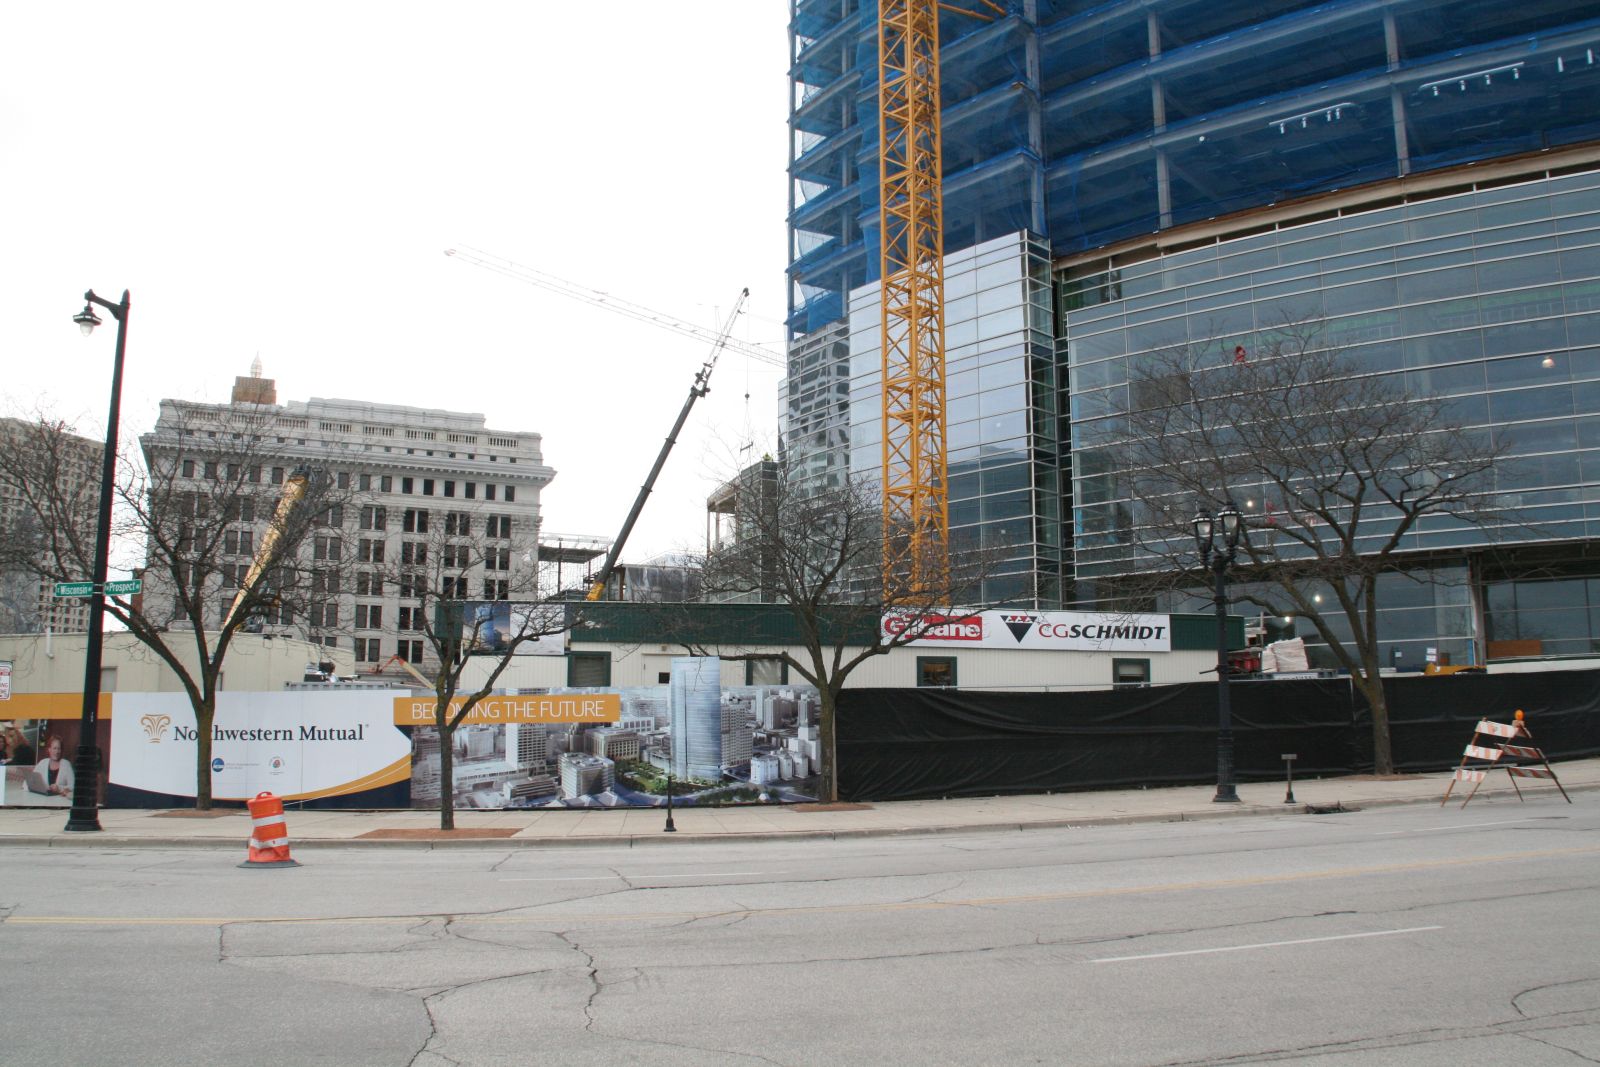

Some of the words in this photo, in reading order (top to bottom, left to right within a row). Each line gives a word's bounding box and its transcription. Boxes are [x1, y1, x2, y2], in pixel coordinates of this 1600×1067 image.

[60, 585, 88, 595] Wisconsin
[109, 582, 136, 593] Prospect
[1038, 623, 1166, 640] CGSCHMIDT
[503, 701, 537, 718] THE
[540, 700, 606, 718] FUTURE
[174, 724, 294, 741] Nohwestern
[299, 724, 365, 741] Mutual
